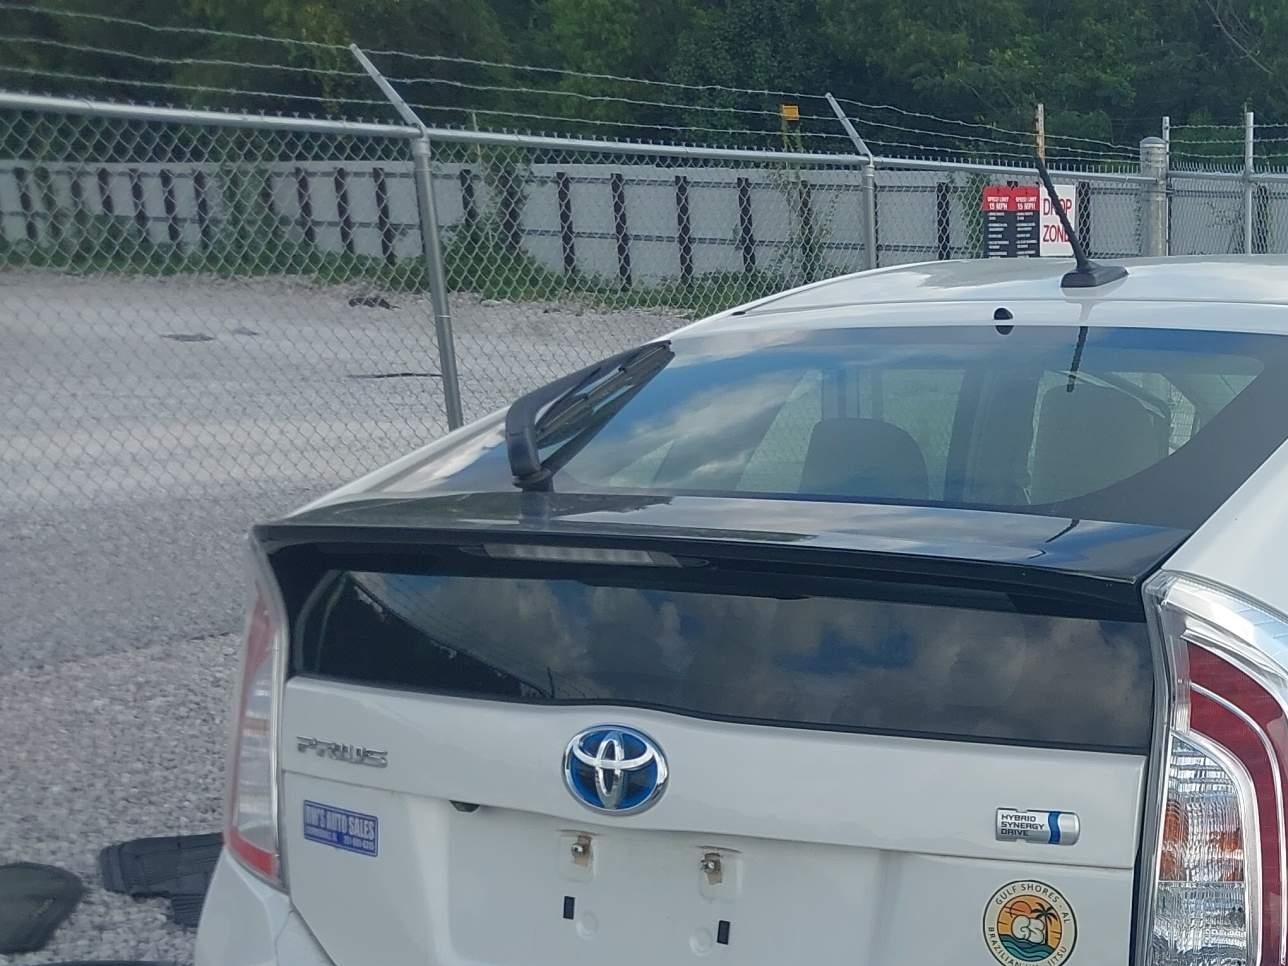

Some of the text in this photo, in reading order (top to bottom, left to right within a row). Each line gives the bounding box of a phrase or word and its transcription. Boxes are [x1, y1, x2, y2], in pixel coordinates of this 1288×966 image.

[296, 736, 388, 769] PRIUS
[1001, 814, 1036, 823] HYBRID
[1001, 821, 1045, 830] SYNERGY
[348, 816, 375, 841] SALES
[1001, 828, 1029, 836] DRIVE
[995, 885, 1017, 905] GULF
[1020, 883, 1060, 903] SHORES
[1061, 911, 1072, 924] AL
